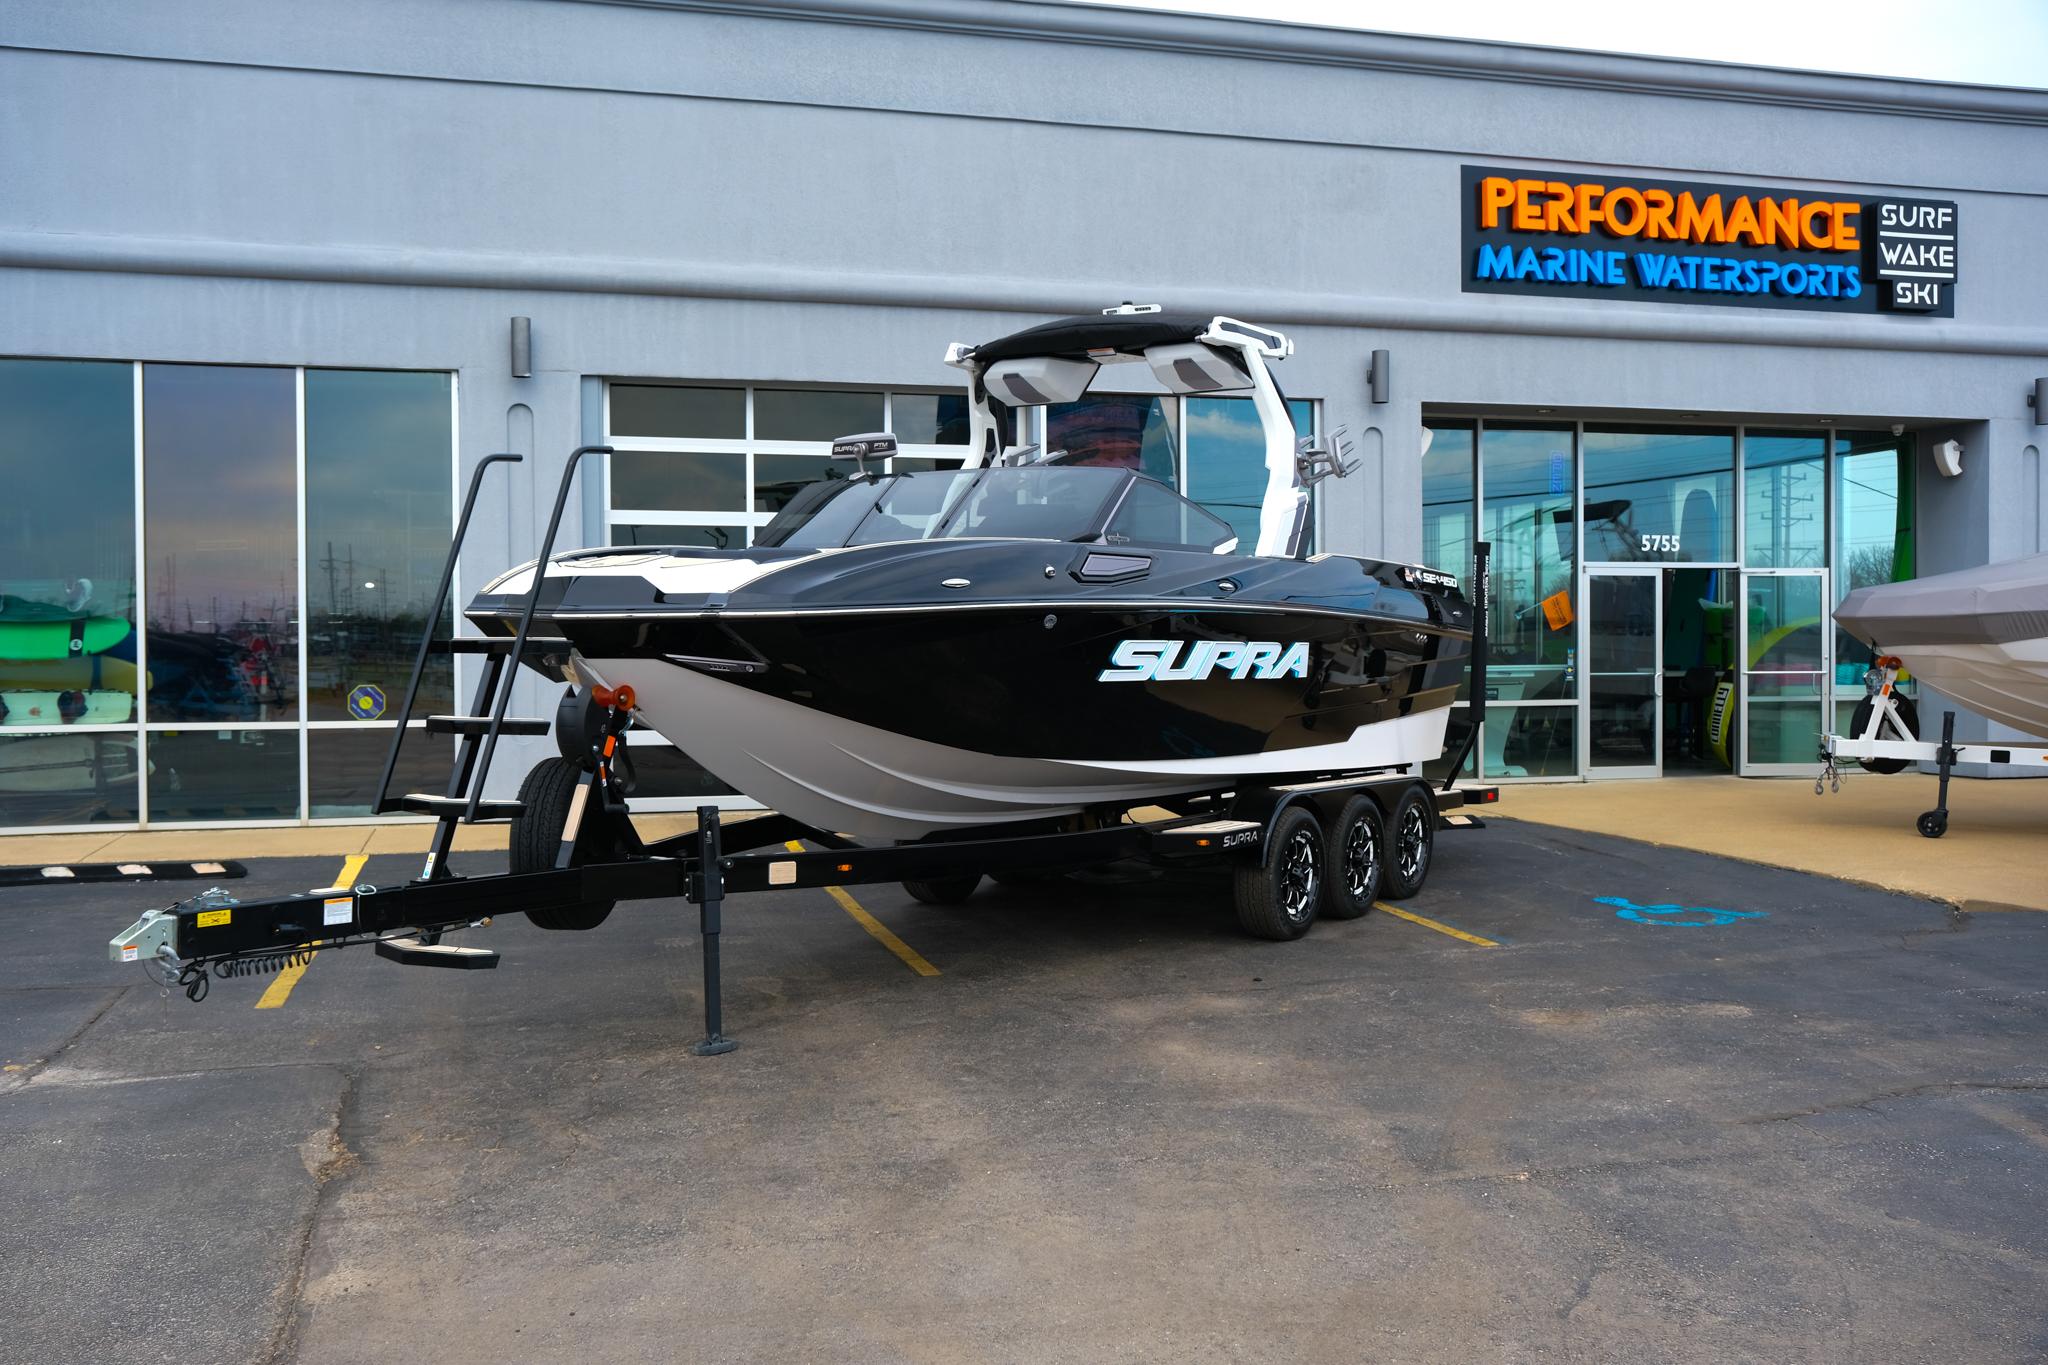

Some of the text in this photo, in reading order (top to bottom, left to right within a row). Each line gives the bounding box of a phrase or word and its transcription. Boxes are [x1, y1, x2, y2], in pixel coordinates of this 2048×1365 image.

[1481, 177, 1861, 250] PERFORMANCE
[1881, 204, 1953, 229] SURF
[1879, 242, 1954, 268] WAKE
[1477, 243, 1862, 298] MARINE WATERSPORTS
[1896, 282, 1939, 305] SKI
[1641, 534, 1680, 551] 5755
[1098, 639, 1310, 682] SUPRA
[1222, 831, 1258, 847] SUPRA
